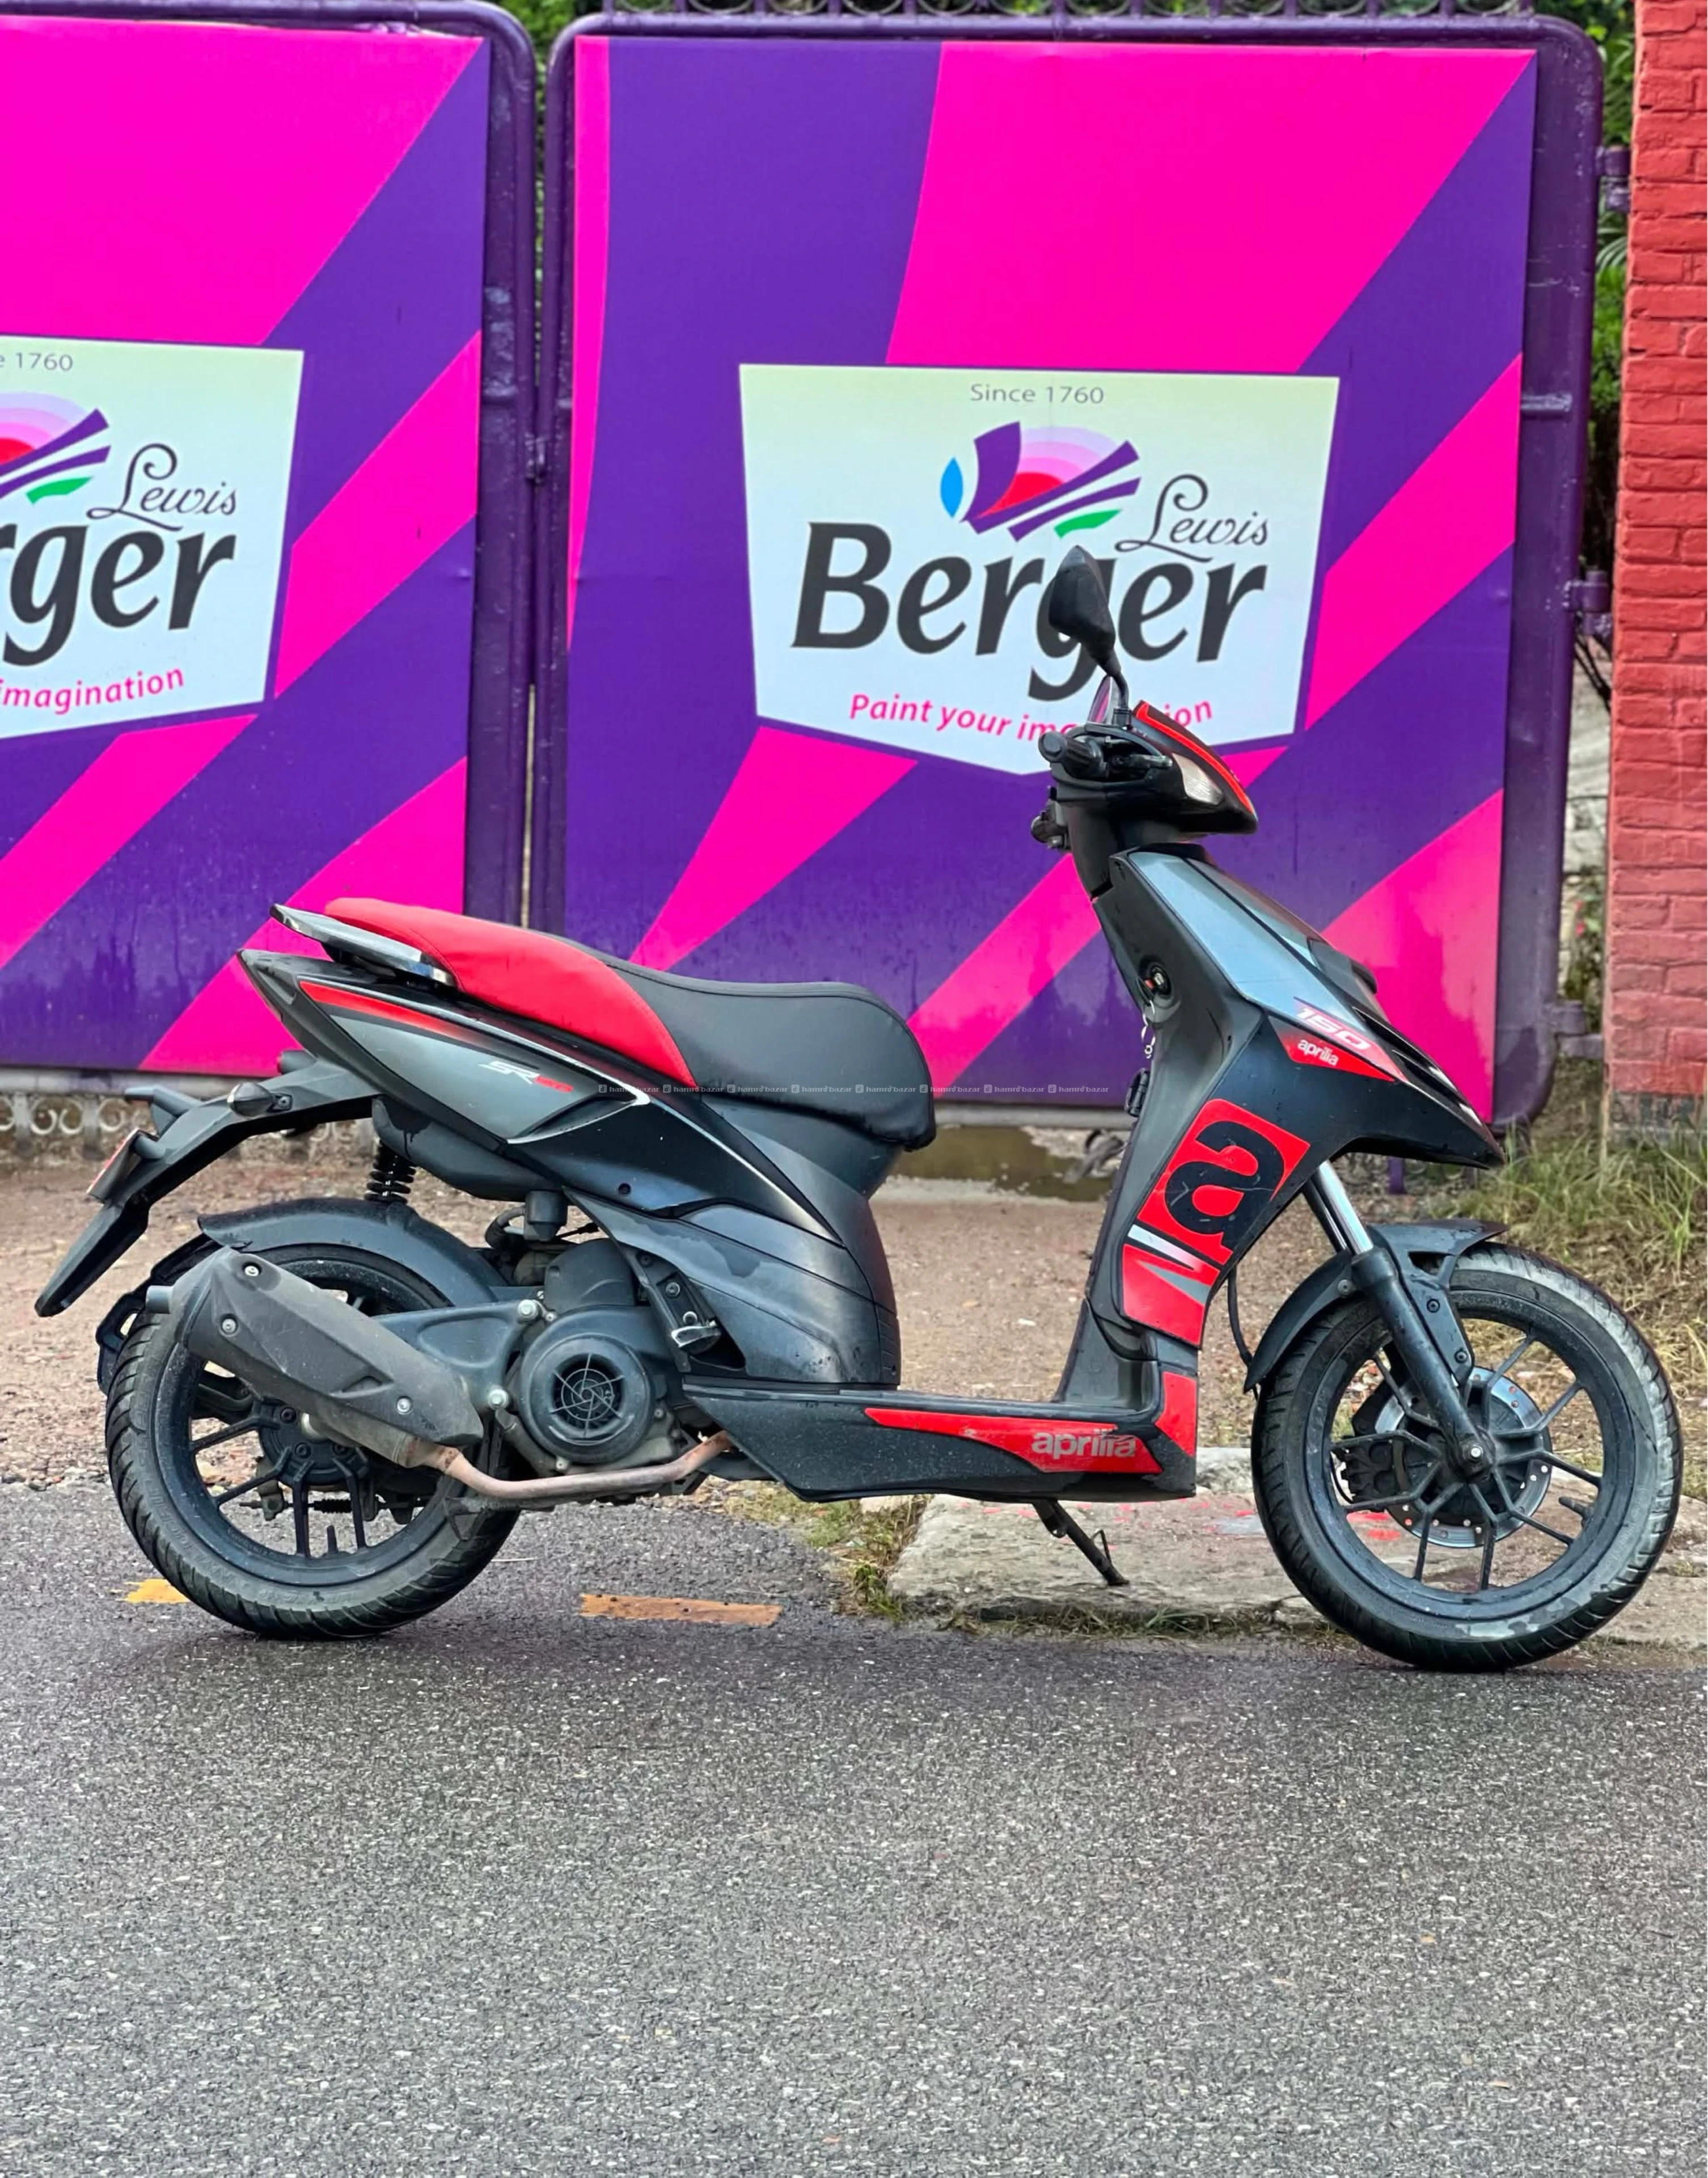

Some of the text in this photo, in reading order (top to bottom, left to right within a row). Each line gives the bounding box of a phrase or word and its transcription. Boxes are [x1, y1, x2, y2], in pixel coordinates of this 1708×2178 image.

[15, 352, 74, 372] 1760
[970, 383, 1105, 404] Since 1760
[86, 443, 236, 531] Lewis
[1114, 474, 1269, 560] Lewis
[0, 521, 236, 666] ger
[790, 521, 1268, 702] Berger
[849, 693, 933, 723] Paint
[936, 706, 1012, 736] your
[1296, 1007, 1371, 1050] 150
[1297, 1039, 1339, 1066] aprilia
[1031, 1428, 1136, 1460] aprilia
